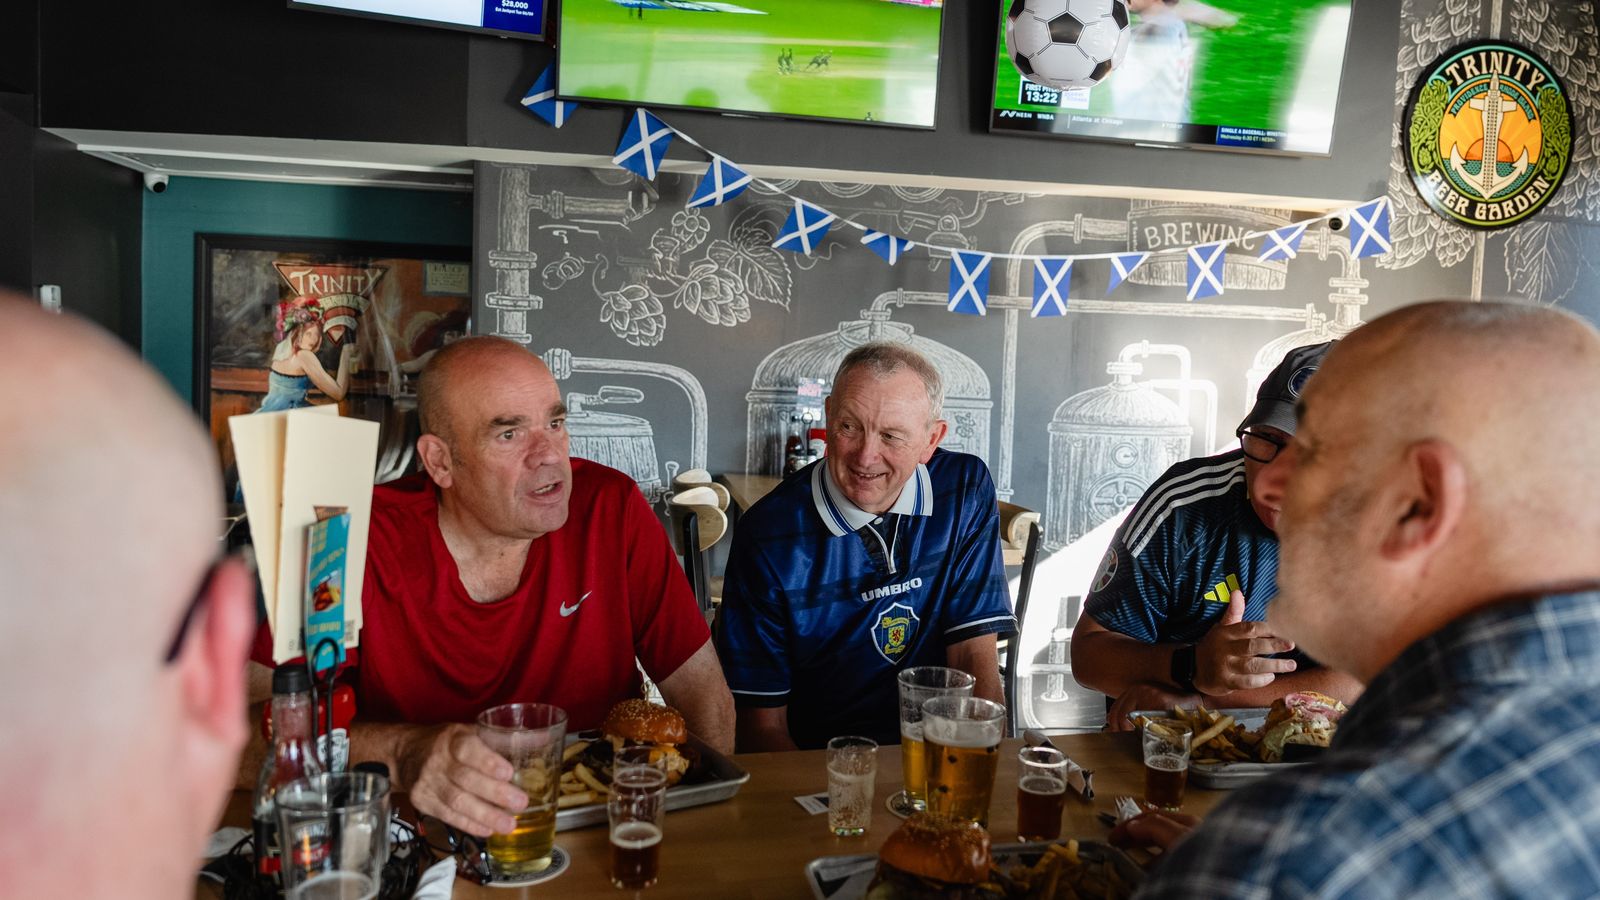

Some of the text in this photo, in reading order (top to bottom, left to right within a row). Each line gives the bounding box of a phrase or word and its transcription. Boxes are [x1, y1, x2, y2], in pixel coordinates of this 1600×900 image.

[1445, 51, 1546, 91] TRINITY
[1025, 83, 1042, 91] FIRST
[1026, 91, 1058, 103] 13:22
[1425, 169, 1550, 220] BEER GARDEN
[289, 268, 383, 296] TRINITY
[861, 577, 923, 602] UMBRO
